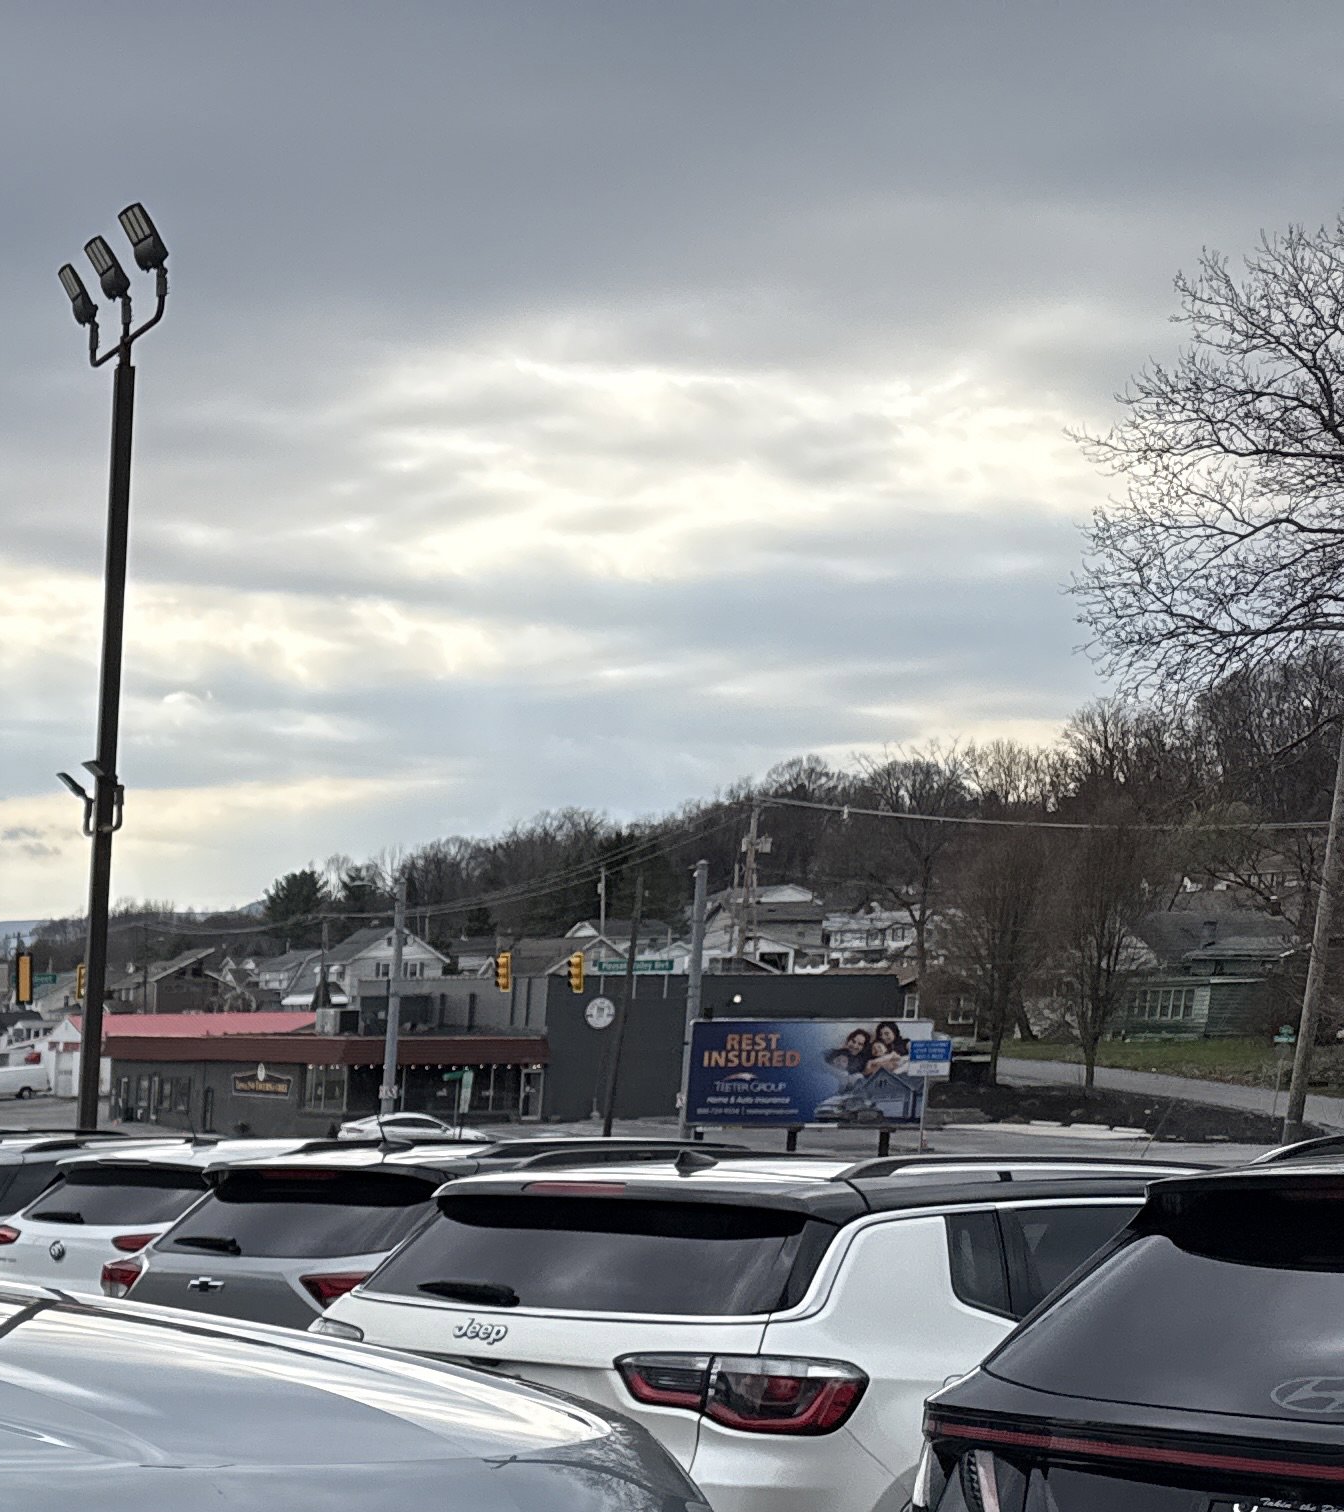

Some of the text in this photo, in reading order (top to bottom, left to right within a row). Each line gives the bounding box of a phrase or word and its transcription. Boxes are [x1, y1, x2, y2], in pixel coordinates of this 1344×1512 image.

[726, 1033, 781, 1051] REST
[703, 1050, 801, 1068] INSURED
[453, 1318, 508, 1345] Jeep
